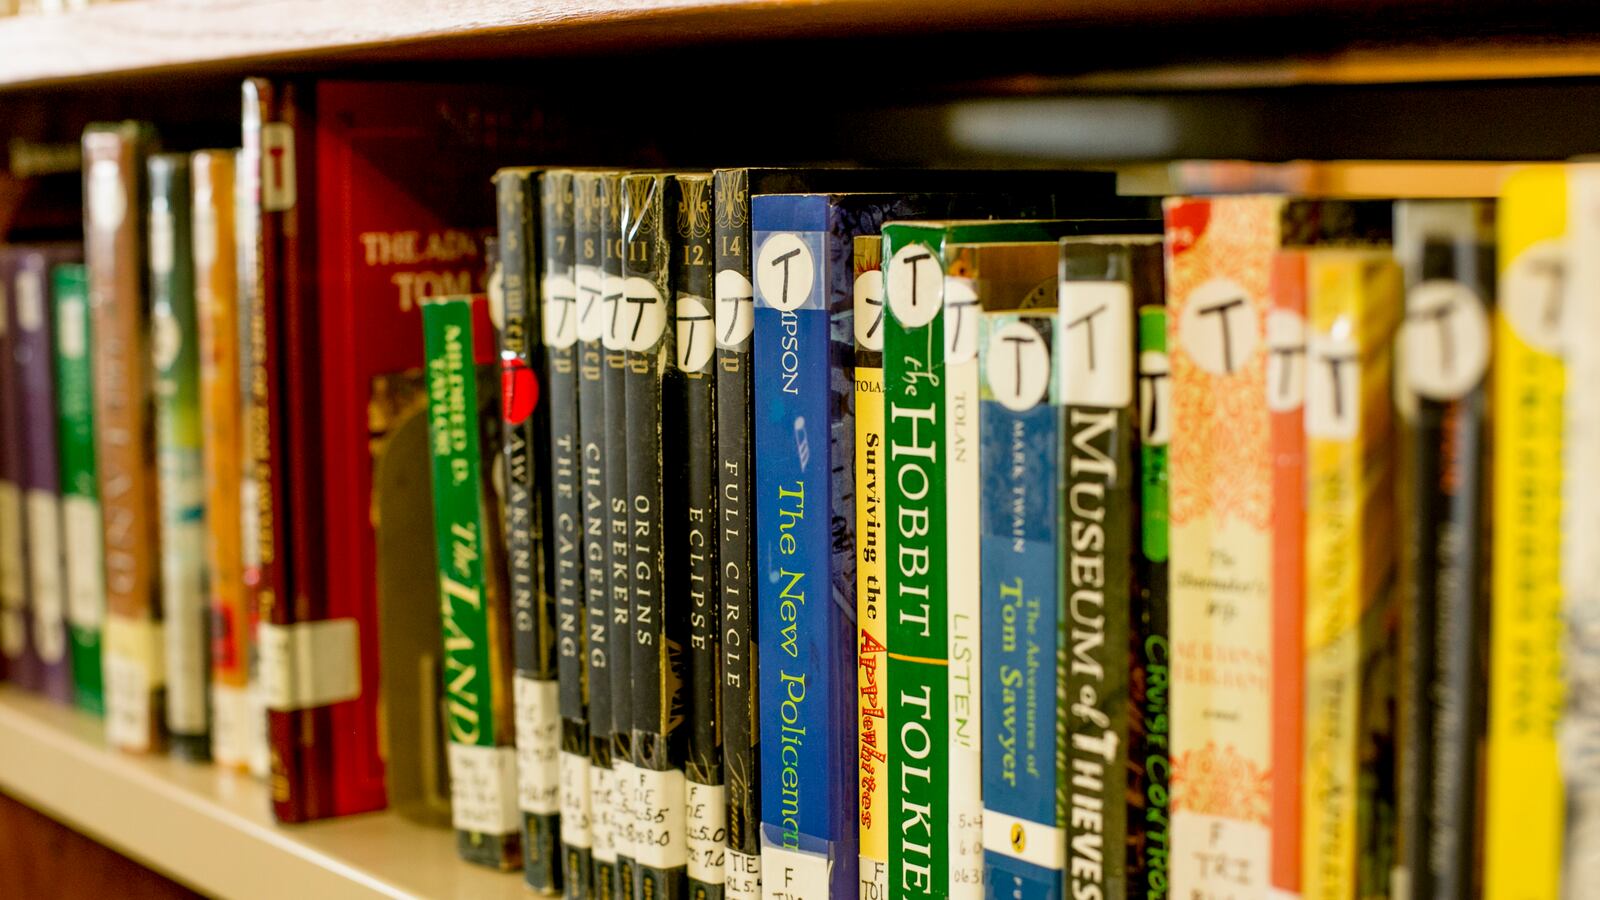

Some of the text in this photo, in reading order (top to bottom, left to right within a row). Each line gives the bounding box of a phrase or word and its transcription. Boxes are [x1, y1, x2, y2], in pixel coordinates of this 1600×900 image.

[360, 231, 418, 265] THE
[556, 237, 566, 249] 7
[583, 239, 595, 258] 8
[629, 242, 648, 261] 11
[684, 245, 704, 265] 12
[721, 236, 741, 257] 14
[772, 248, 801, 303] T
[903, 253, 931, 306] T
[553, 296, 576, 338] T
[603, 293, 623, 339] T
[626, 298, 657, 341] T
[677, 315, 712, 366] T
[721, 296, 754, 342] T
[945, 300, 979, 353] T
[1066, 303, 1108, 372] T
[1198, 298, 1244, 375] T
[445, 325, 467, 451] MILDRED
[1002, 337, 1036, 397] T
[1321, 353, 1357, 417] T
[430, 358, 451, 456] TAYLOR
[955, 392, 967, 463] TOLAN
[1139, 371, 1169, 438] T
[778, 481, 805, 555] The
[891, 402, 937, 637] HOBBIT
[1012, 419, 1026, 553] MARK TWAIN
[451, 521, 478, 578] The
[510, 434, 532, 632] AWAKENING
[557, 434, 577, 657] THE CALLING
[586, 443, 607, 667] CHANGELING
[612, 498, 629, 624] SEEKER
[1069, 408, 1118, 680] MUSEUM
[634, 495, 652, 645] ORIGINS
[689, 507, 706, 651] ECLIPSE
[725, 461, 741, 688] FULL CIRCLE
[779, 568, 806, 657] New
[859, 433, 887, 829] Surviving the Applewhites
[441, 574, 482, 745] LAND
[953, 614, 972, 747] LISTEN!
[998, 576, 1023, 787] Tom Sawyer
[1026, 597, 1041, 778] The Adventures of
[1071, 684, 1110, 729] of
[690, 787, 698, 801] F
[901, 686, 931, 900] TOLKIE
[730, 853, 759, 873] TIE
[784, 867, 794, 888] F
[874, 862, 884, 880] F
